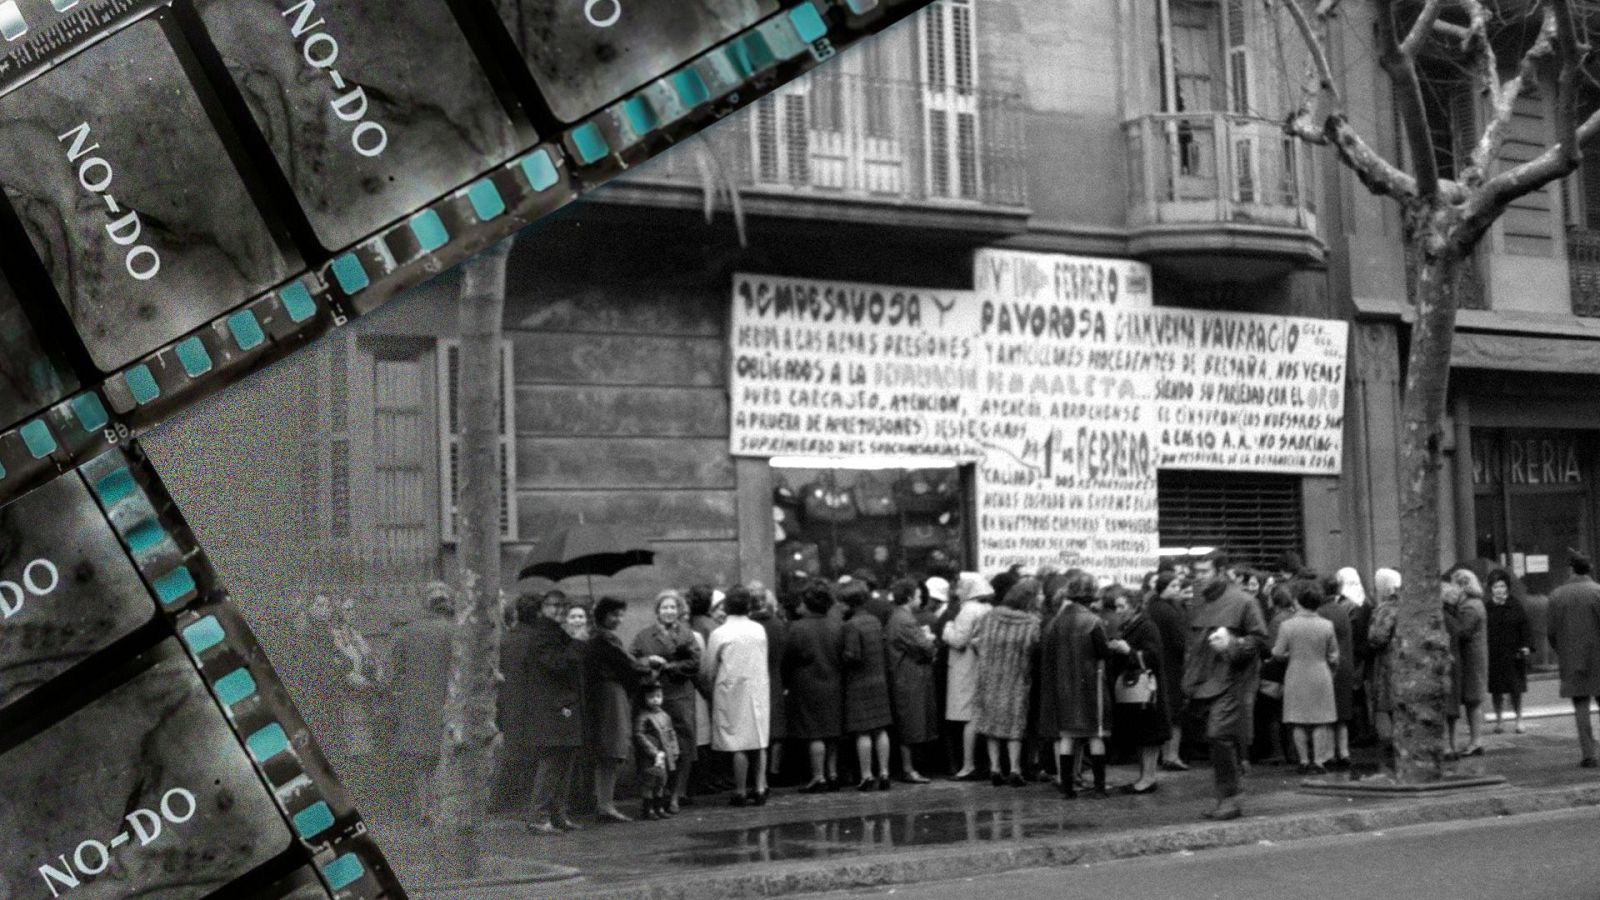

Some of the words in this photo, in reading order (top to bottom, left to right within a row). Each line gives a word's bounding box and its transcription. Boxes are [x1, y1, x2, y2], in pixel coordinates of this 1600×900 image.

[931, 294, 956, 327] Y
[981, 301, 1106, 342] PAVOROSA
[830, 362, 841, 385] A
[848, 362, 867, 385] LA
[1161, 429, 1170, 446] A
